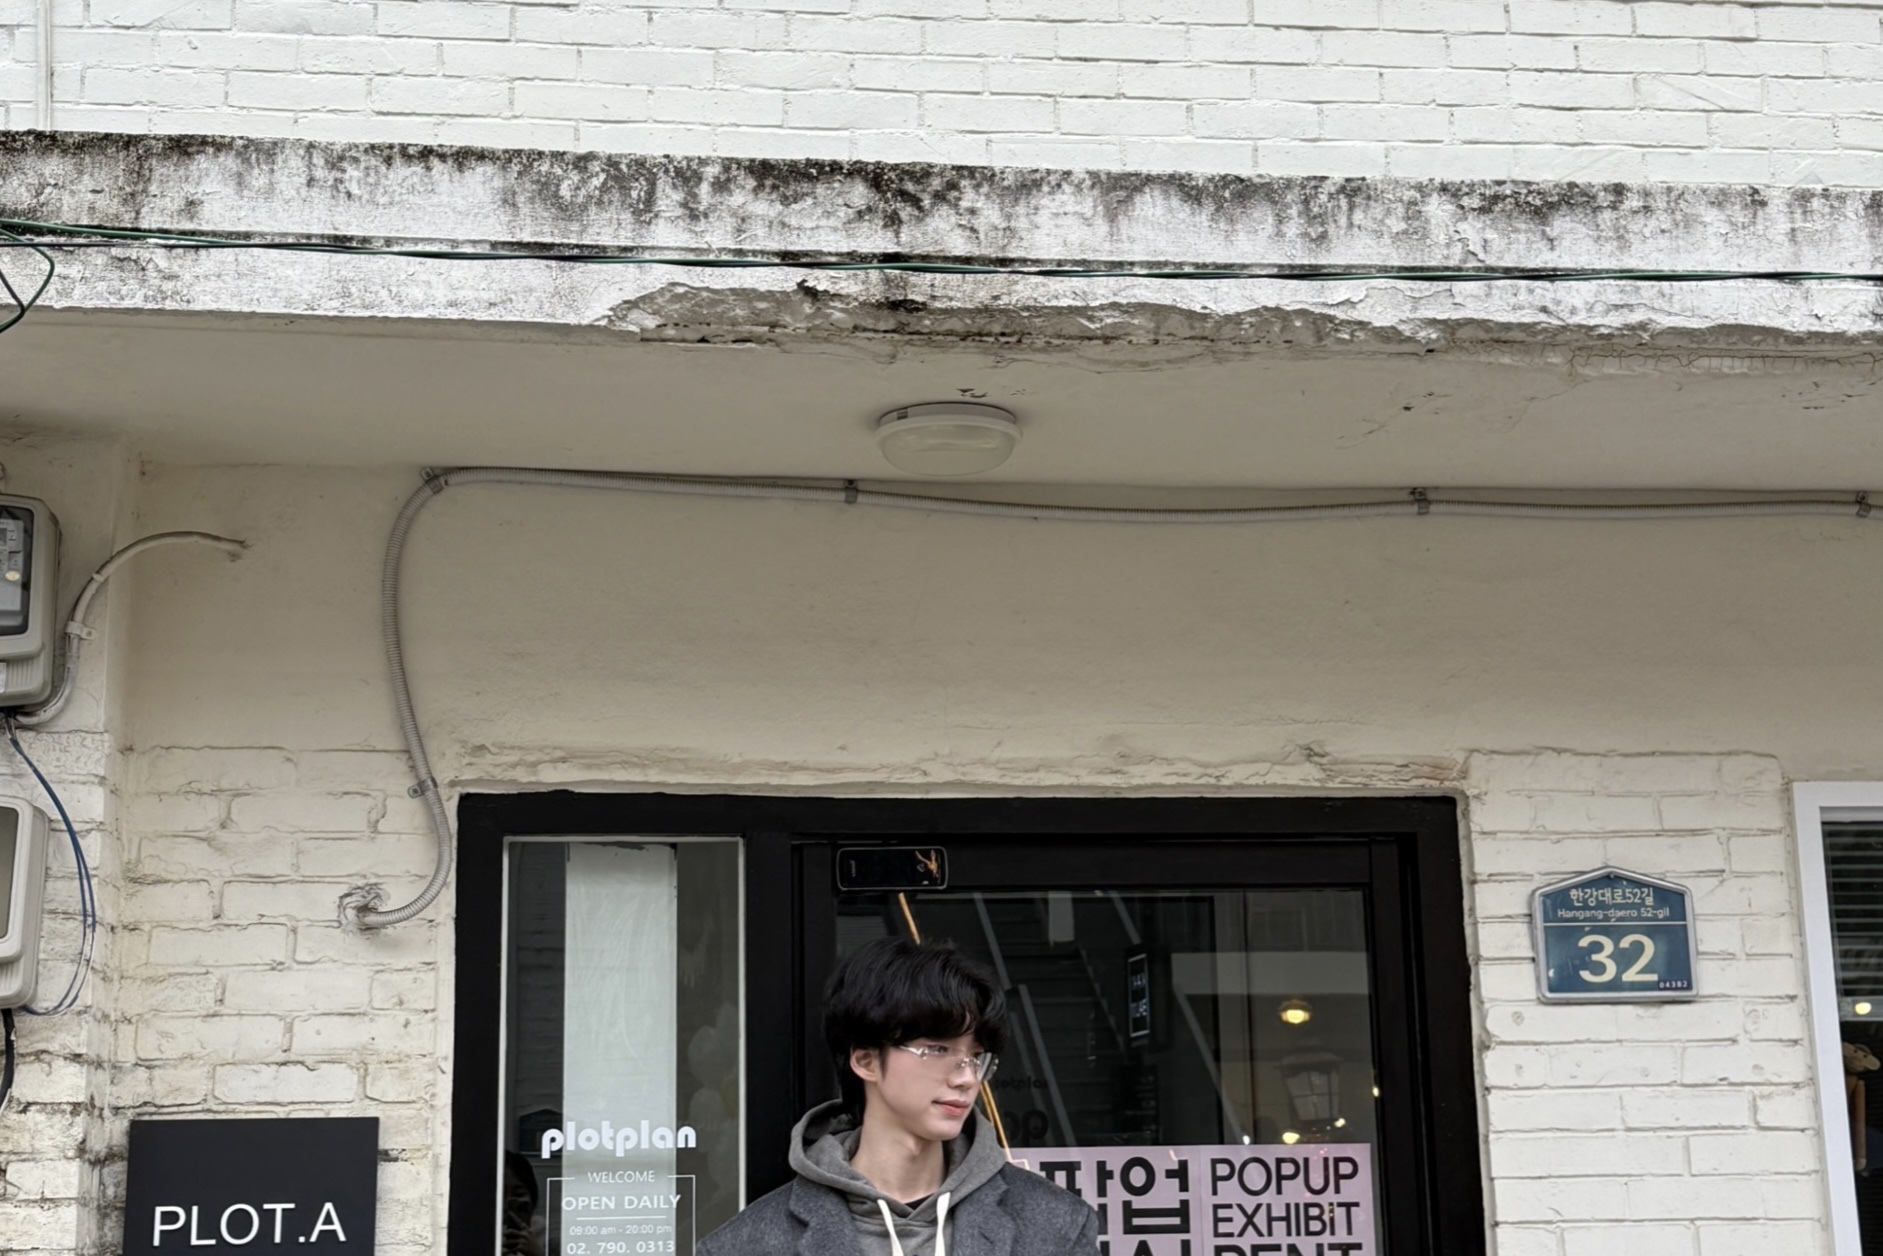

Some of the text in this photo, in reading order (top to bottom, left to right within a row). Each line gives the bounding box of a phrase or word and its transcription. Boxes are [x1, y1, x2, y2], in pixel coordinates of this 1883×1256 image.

[1569, 886, 1654, 907] 한강대로52길
[1557, 906, 1670, 920] Hangang-daero 52-gil
[1577, 933, 1659, 983] 32
[541, 1119, 697, 1159] plotplan
[588, 1170, 656, 1183] WELCOME
[1210, 1156, 1360, 1197] POPUP
[562, 1194, 682, 1211] OPEN DAILY
[152, 1202, 347, 1247] PLOT.A
[600, 1226, 617, 1235] am
[625, 1224, 654, 1234] 20:00
[656, 1225, 673, 1235] pm
[566, 1240, 676, 1255] 02. 790. 0313
